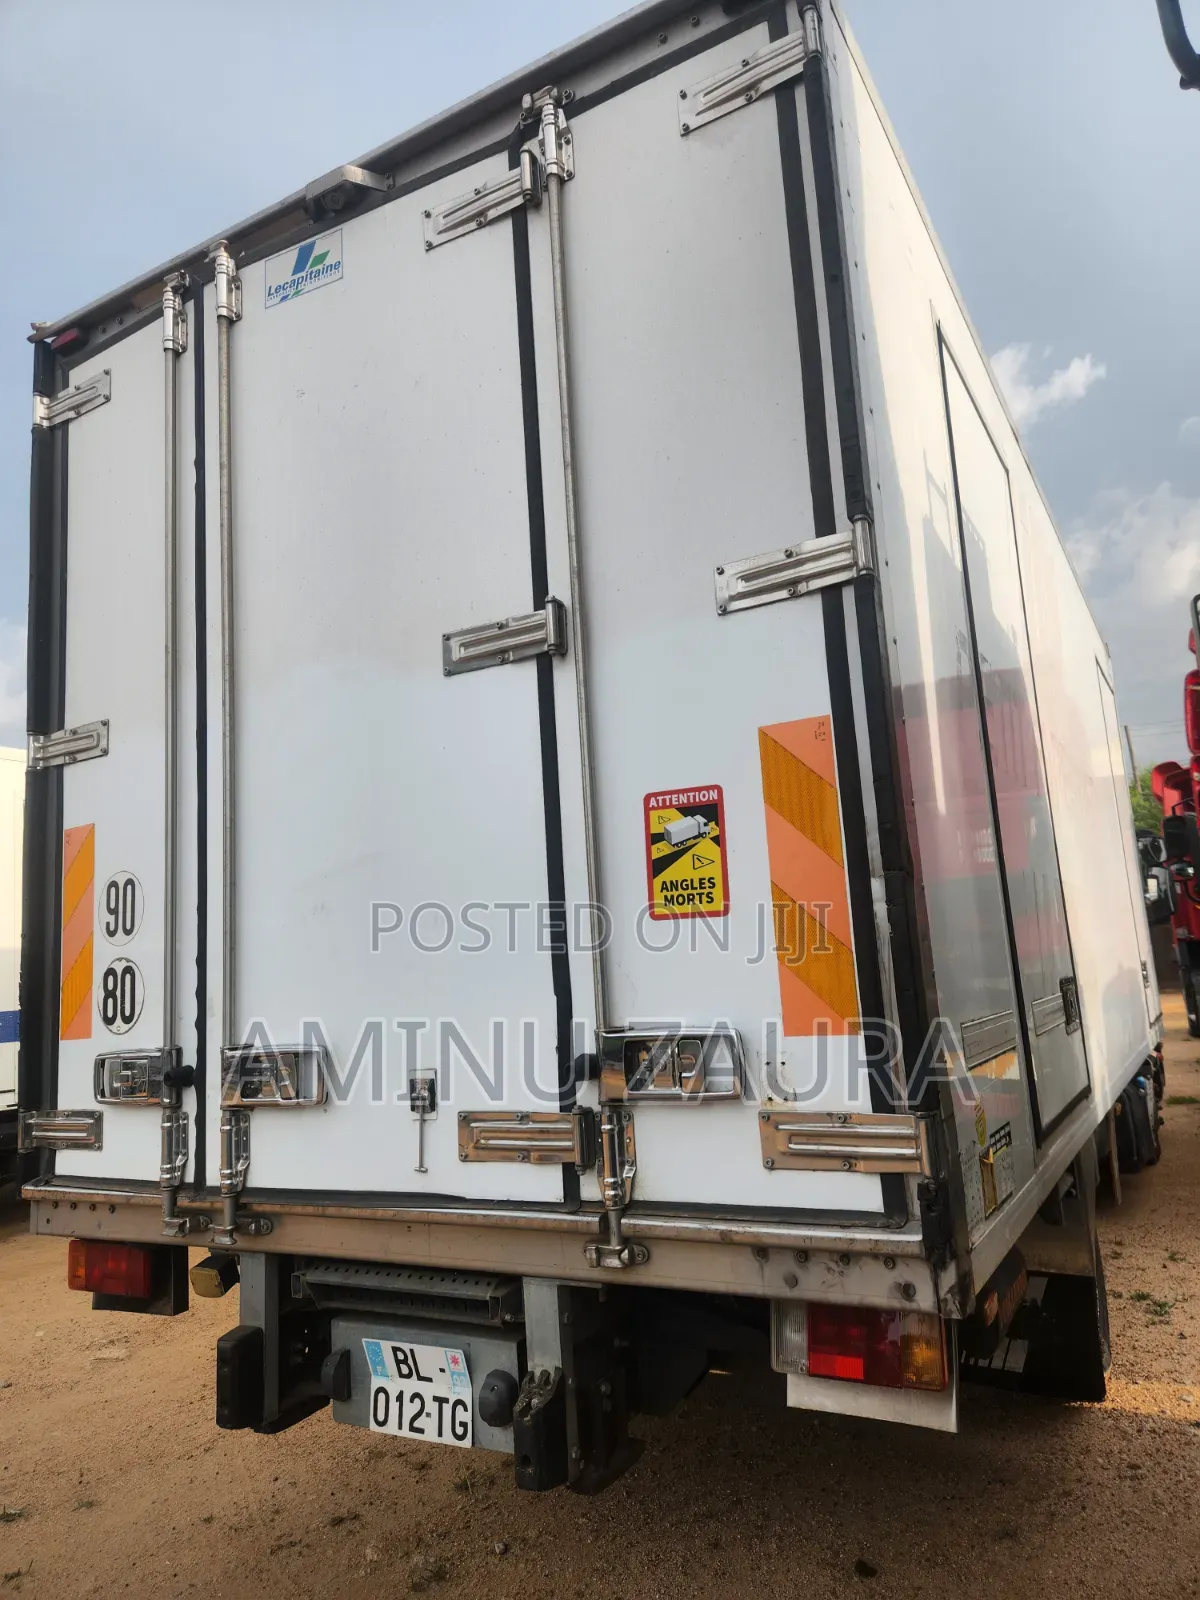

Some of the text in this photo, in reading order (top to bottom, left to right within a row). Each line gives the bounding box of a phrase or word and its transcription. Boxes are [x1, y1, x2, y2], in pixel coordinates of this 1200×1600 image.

[267, 260, 341, 297] Lecapitaine
[649, 789, 718, 808] ATTENTION
[660, 877, 716, 893] ANGLES
[663, 891, 715, 907] MORTS
[105, 878, 136, 938] 90
[102, 965, 136, 1026] 80
[372, 1385, 469, 1442] 012-TG
